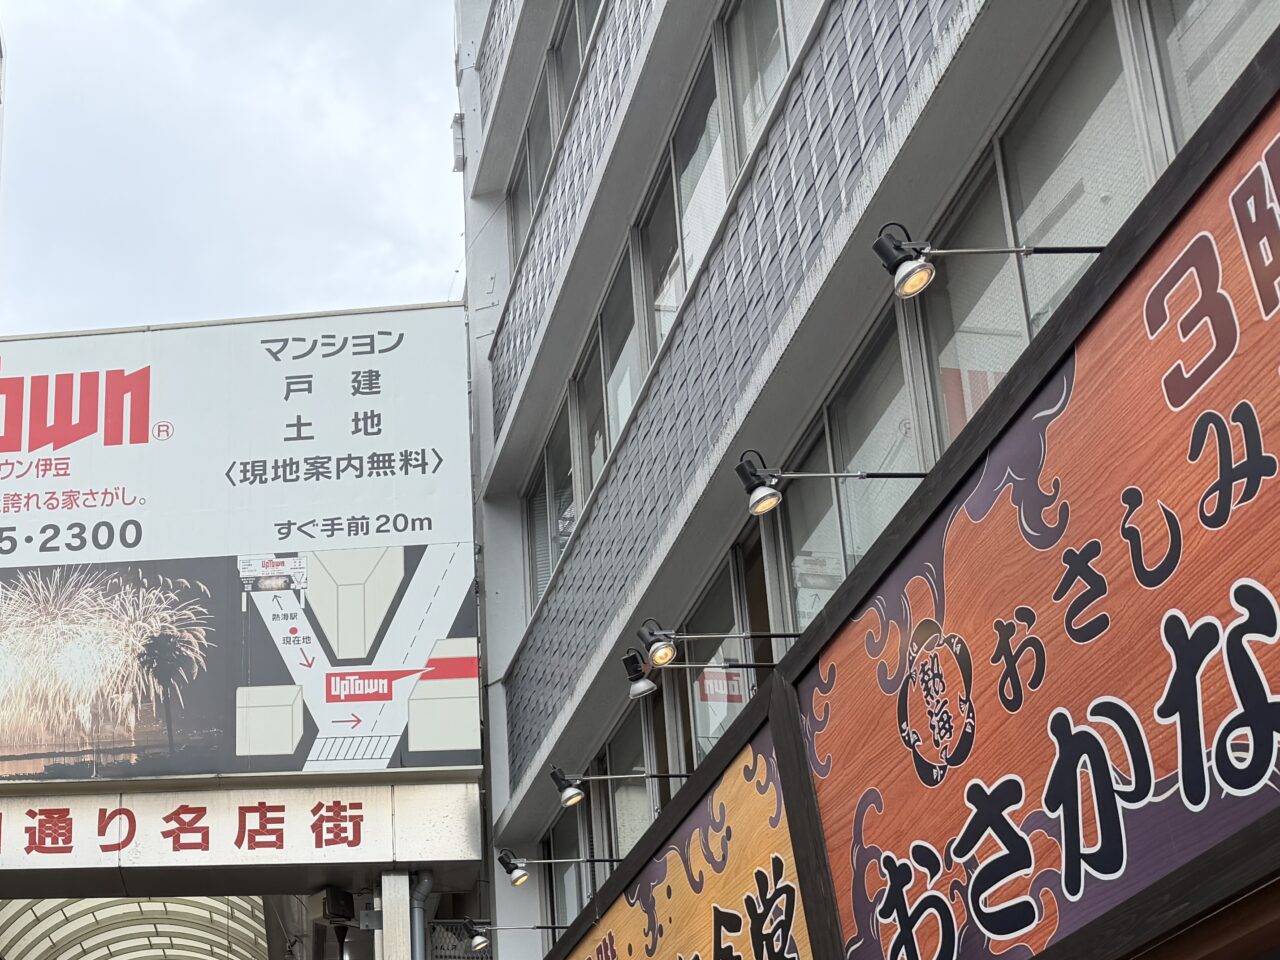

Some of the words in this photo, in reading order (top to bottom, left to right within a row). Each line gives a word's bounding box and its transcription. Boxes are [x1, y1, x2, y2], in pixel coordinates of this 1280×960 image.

[260, 330, 405, 362] マンション
[282, 635, 312, 646] 現在地
[330, 675, 389, 700] UpTown
